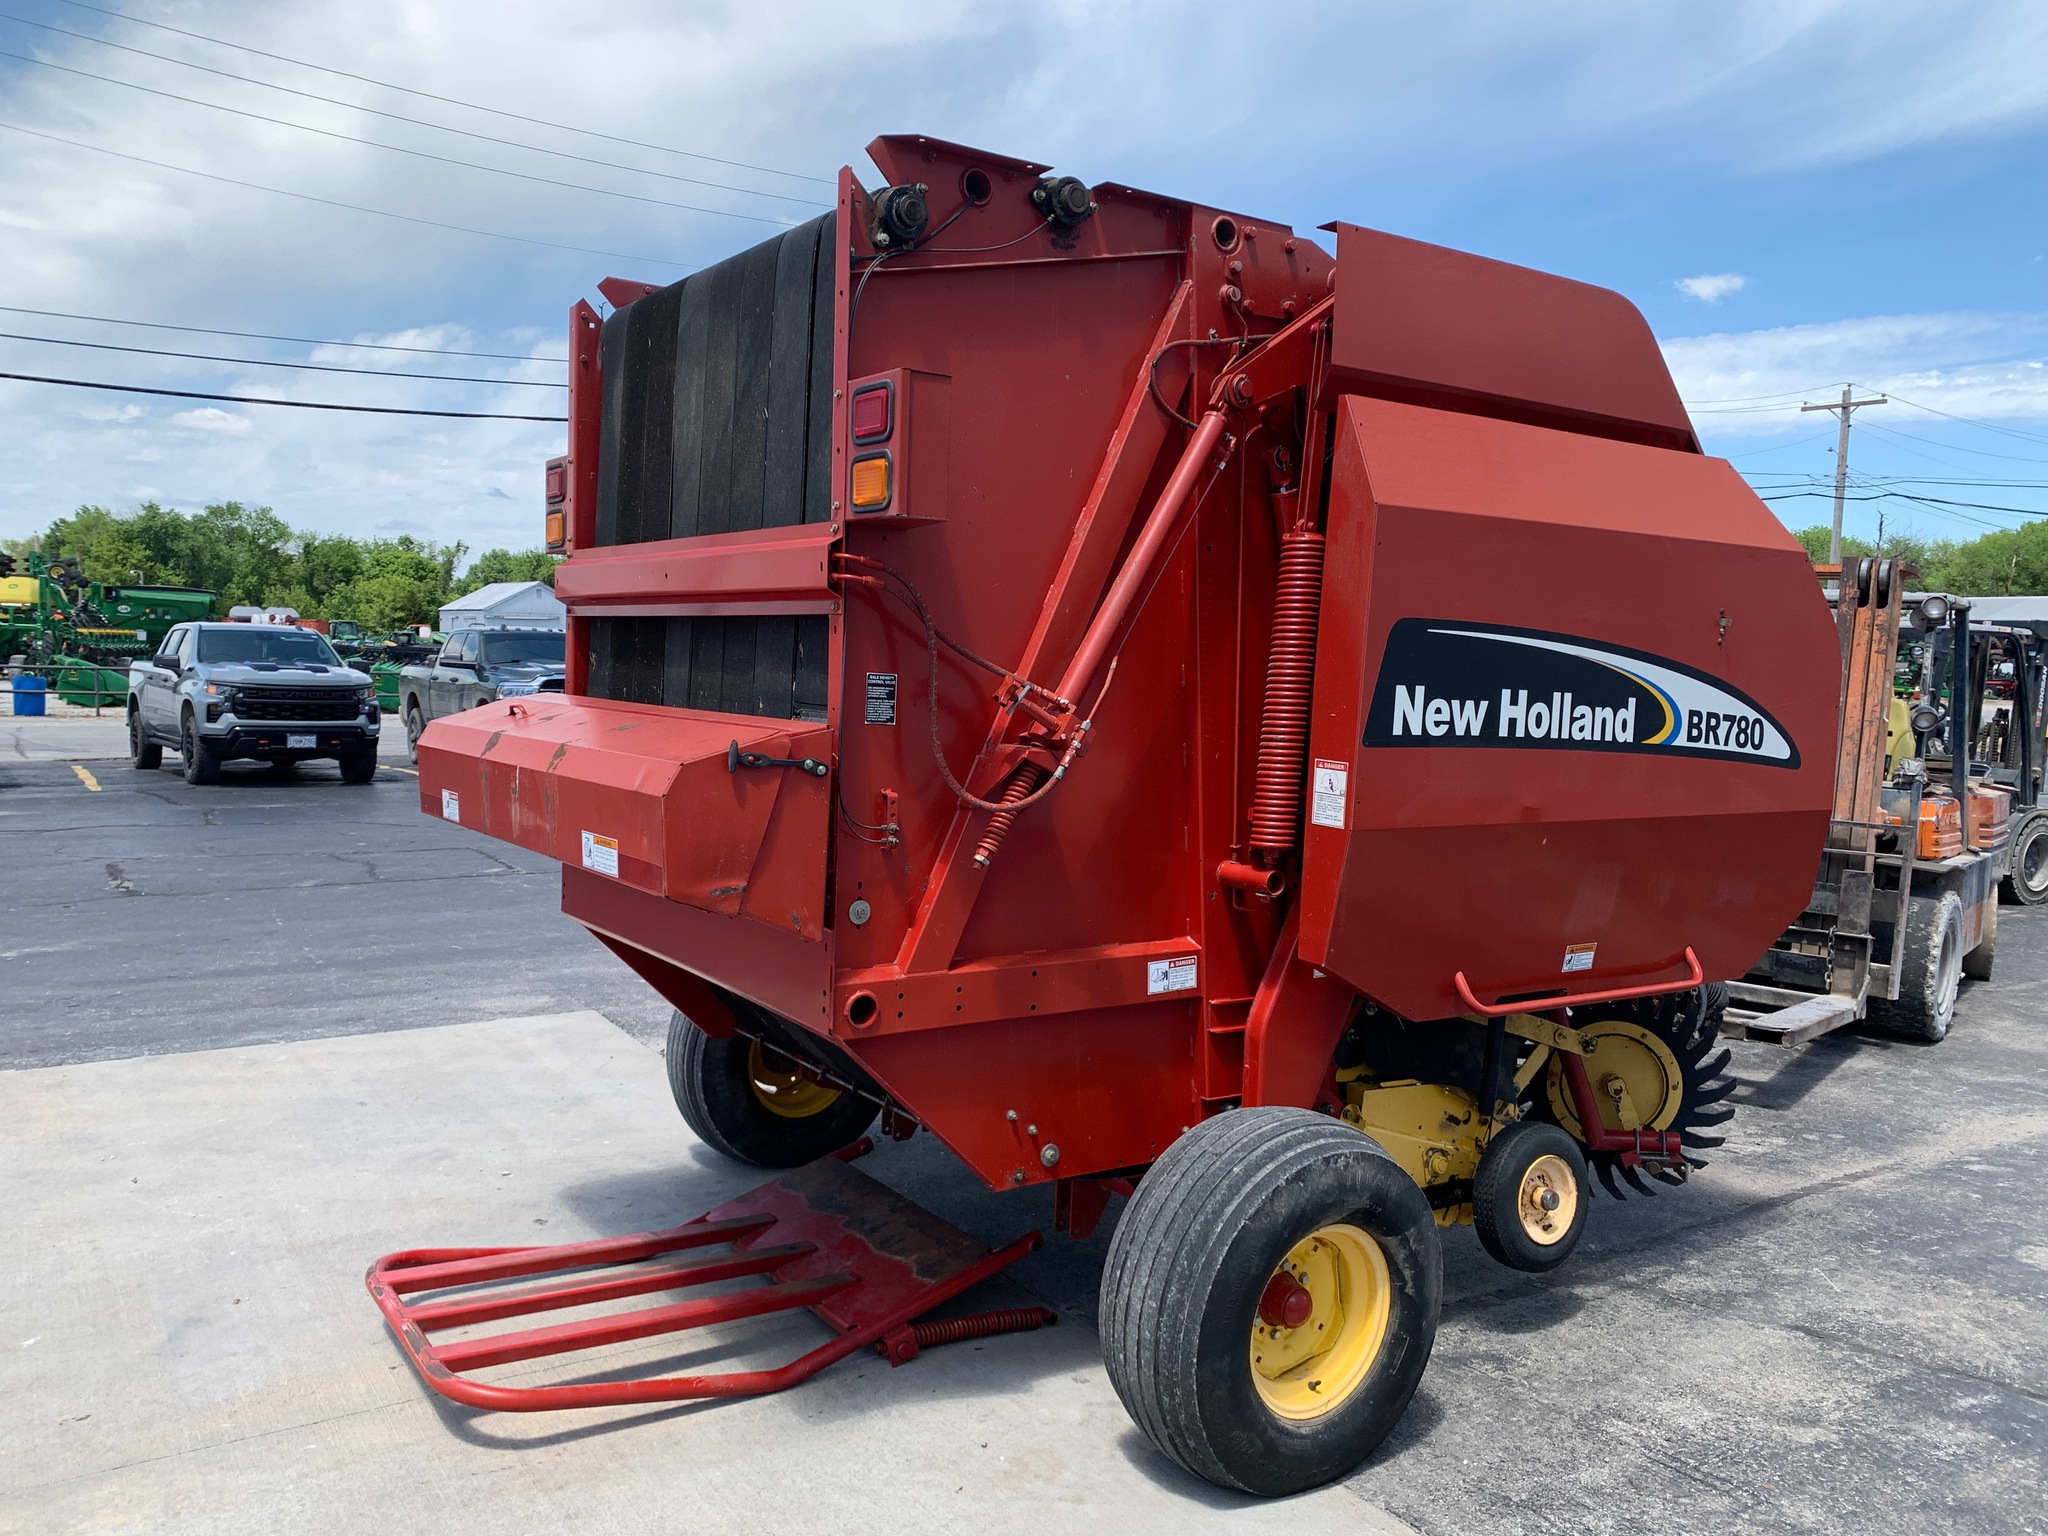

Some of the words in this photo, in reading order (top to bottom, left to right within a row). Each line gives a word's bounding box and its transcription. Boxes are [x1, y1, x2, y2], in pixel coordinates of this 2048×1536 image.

[246, 690, 354, 699] CHEVROLET
[2038, 665, 2048, 709] DOOSAN
[1392, 684, 1489, 738] New
[1499, 689, 1637, 743] Holland
[1686, 709, 1764, 751] BR780
[1324, 762, 1344, 770] DANGER
